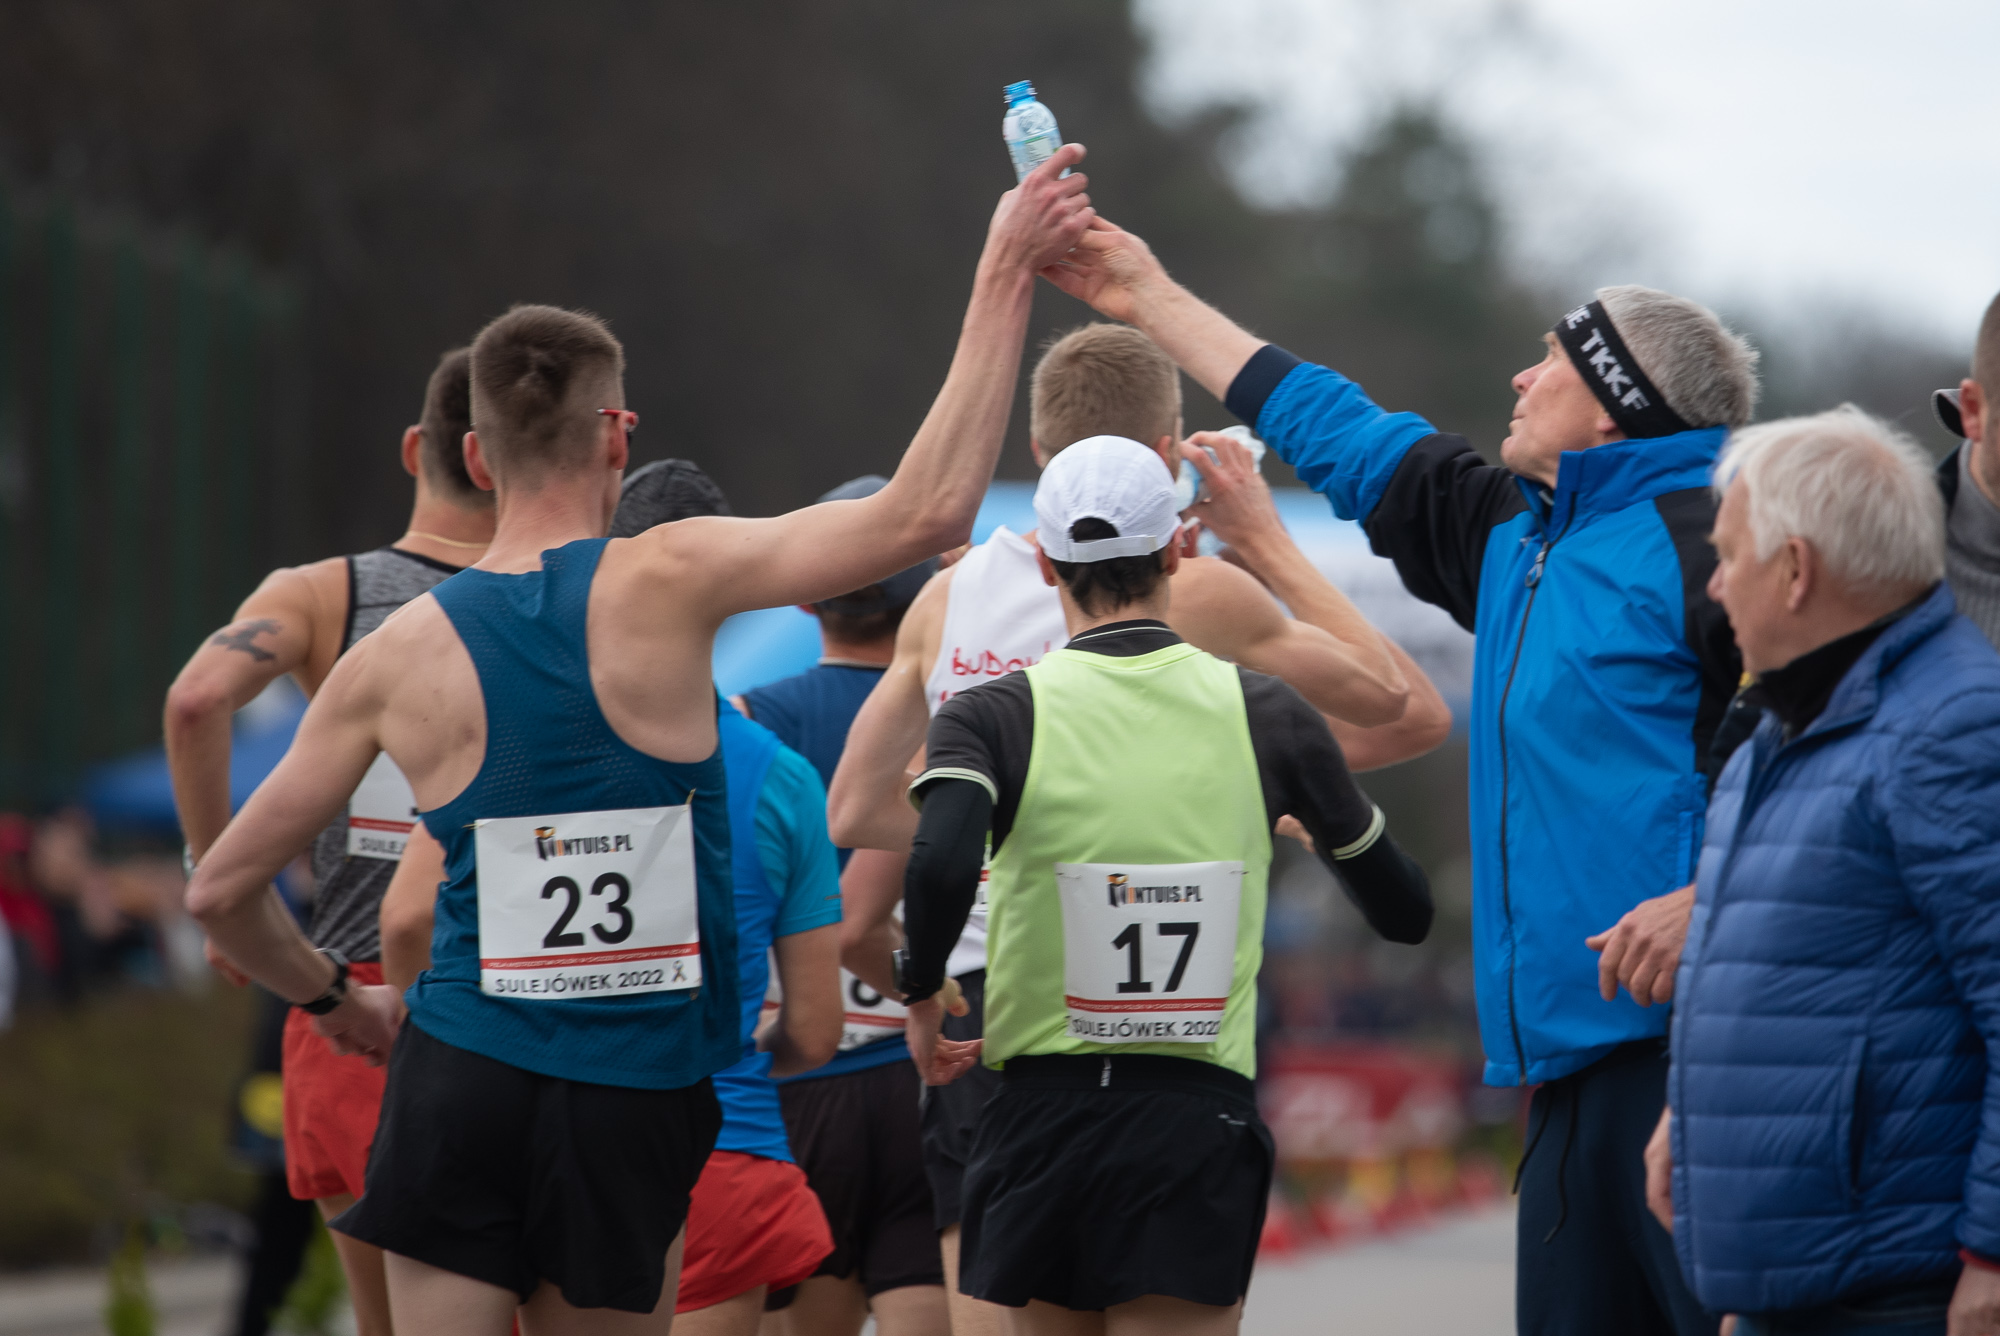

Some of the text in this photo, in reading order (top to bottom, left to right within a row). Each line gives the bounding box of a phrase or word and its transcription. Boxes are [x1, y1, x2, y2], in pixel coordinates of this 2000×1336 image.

[1580, 327, 1650, 410] TKKF
[541, 871, 634, 949] 23
[495, 968, 664, 993] SULEJÓWEK 2022
[1111, 921, 1201, 994] 17
[1071, 1018, 1177, 1038] SULEJÓWEK
